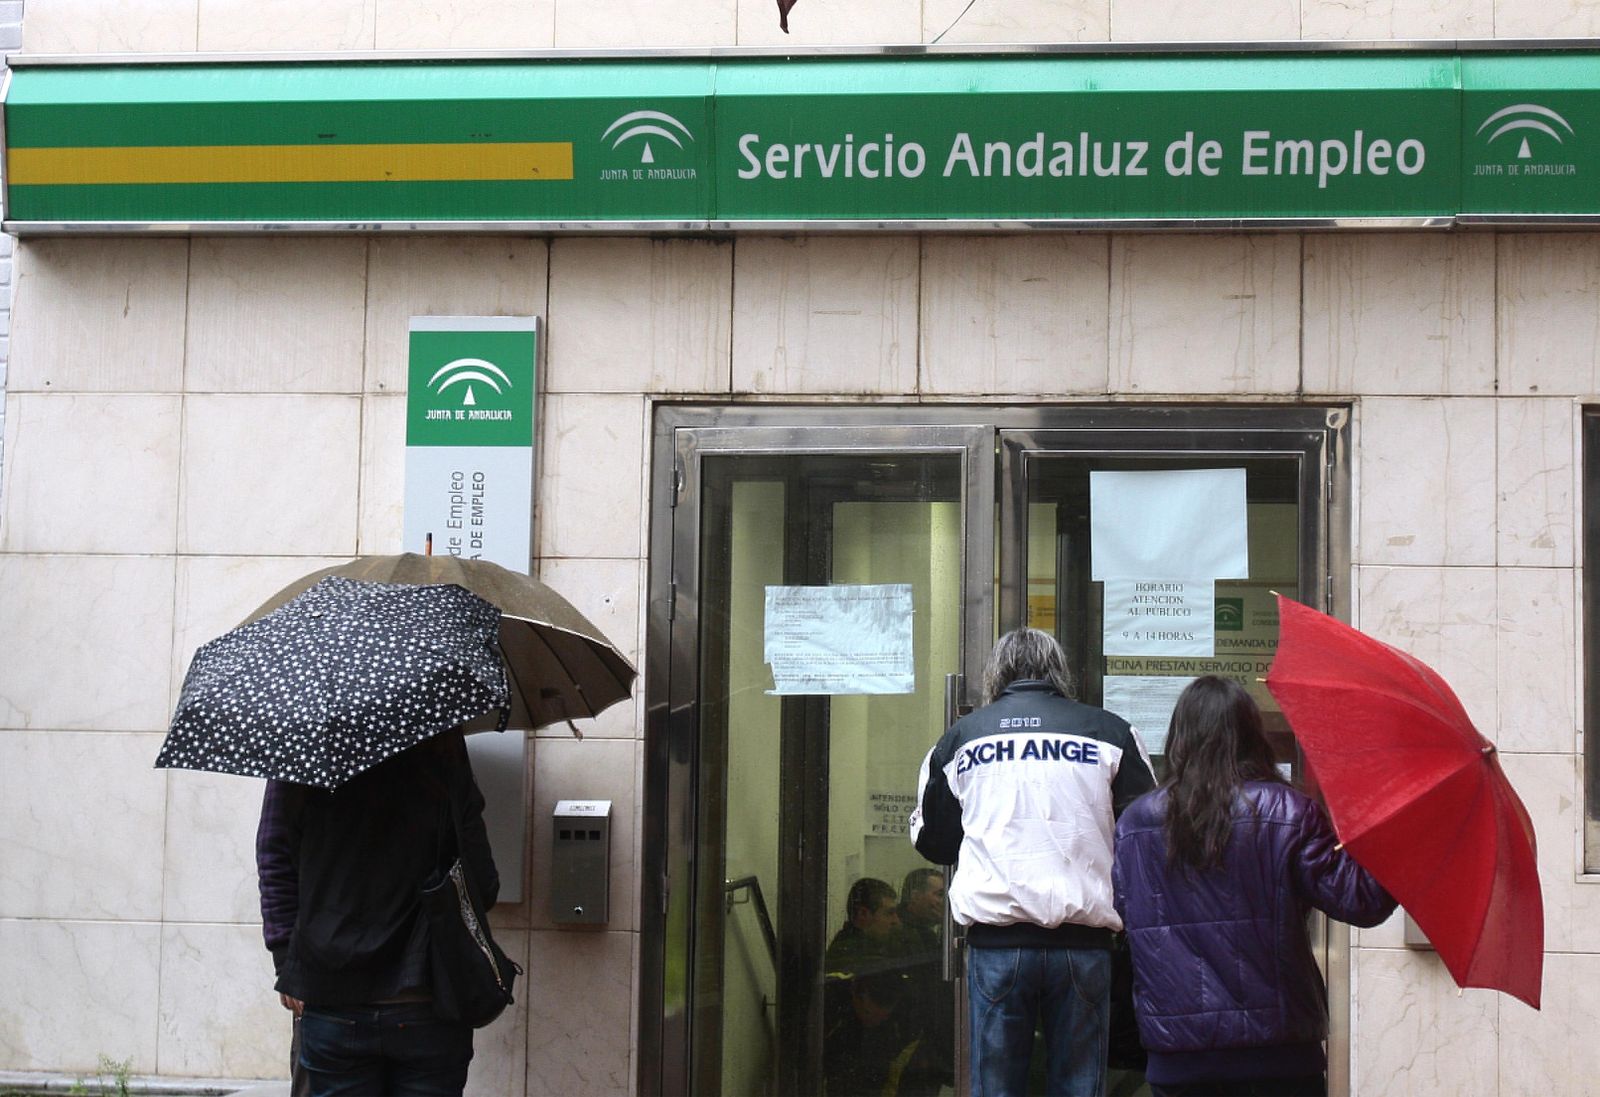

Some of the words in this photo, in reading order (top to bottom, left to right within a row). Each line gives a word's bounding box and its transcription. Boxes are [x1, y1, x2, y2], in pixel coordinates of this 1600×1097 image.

[737, 133, 926, 179] Servicio
[942, 131, 1149, 177] Andaluz
[1164, 131, 1223, 177] de
[1241, 129, 1426, 189] Empleo
[600, 169, 628, 180] JUNTA
[632, 169, 643, 180] DE
[648, 168, 697, 180] ANDALUCIA
[1473, 164, 1503, 176] JUNTA
[1508, 164, 1519, 176] DE
[1524, 164, 1576, 176] ANDALUCIA
[425, 409, 451, 420] JUNTA
[455, 409, 465, 420] DE
[447, 471, 467, 529] Empleo
[471, 471, 485, 526] EMPLEO
[470, 531, 483, 549] DE
[1135, 583, 1184, 592] HORARIO
[1158, 631, 1194, 641] HORAS
[1146, 660, 1195, 672] PRESTAN
[1200, 662, 1252, 673] SERVICIO
[1000, 717, 1041, 728] 2010
